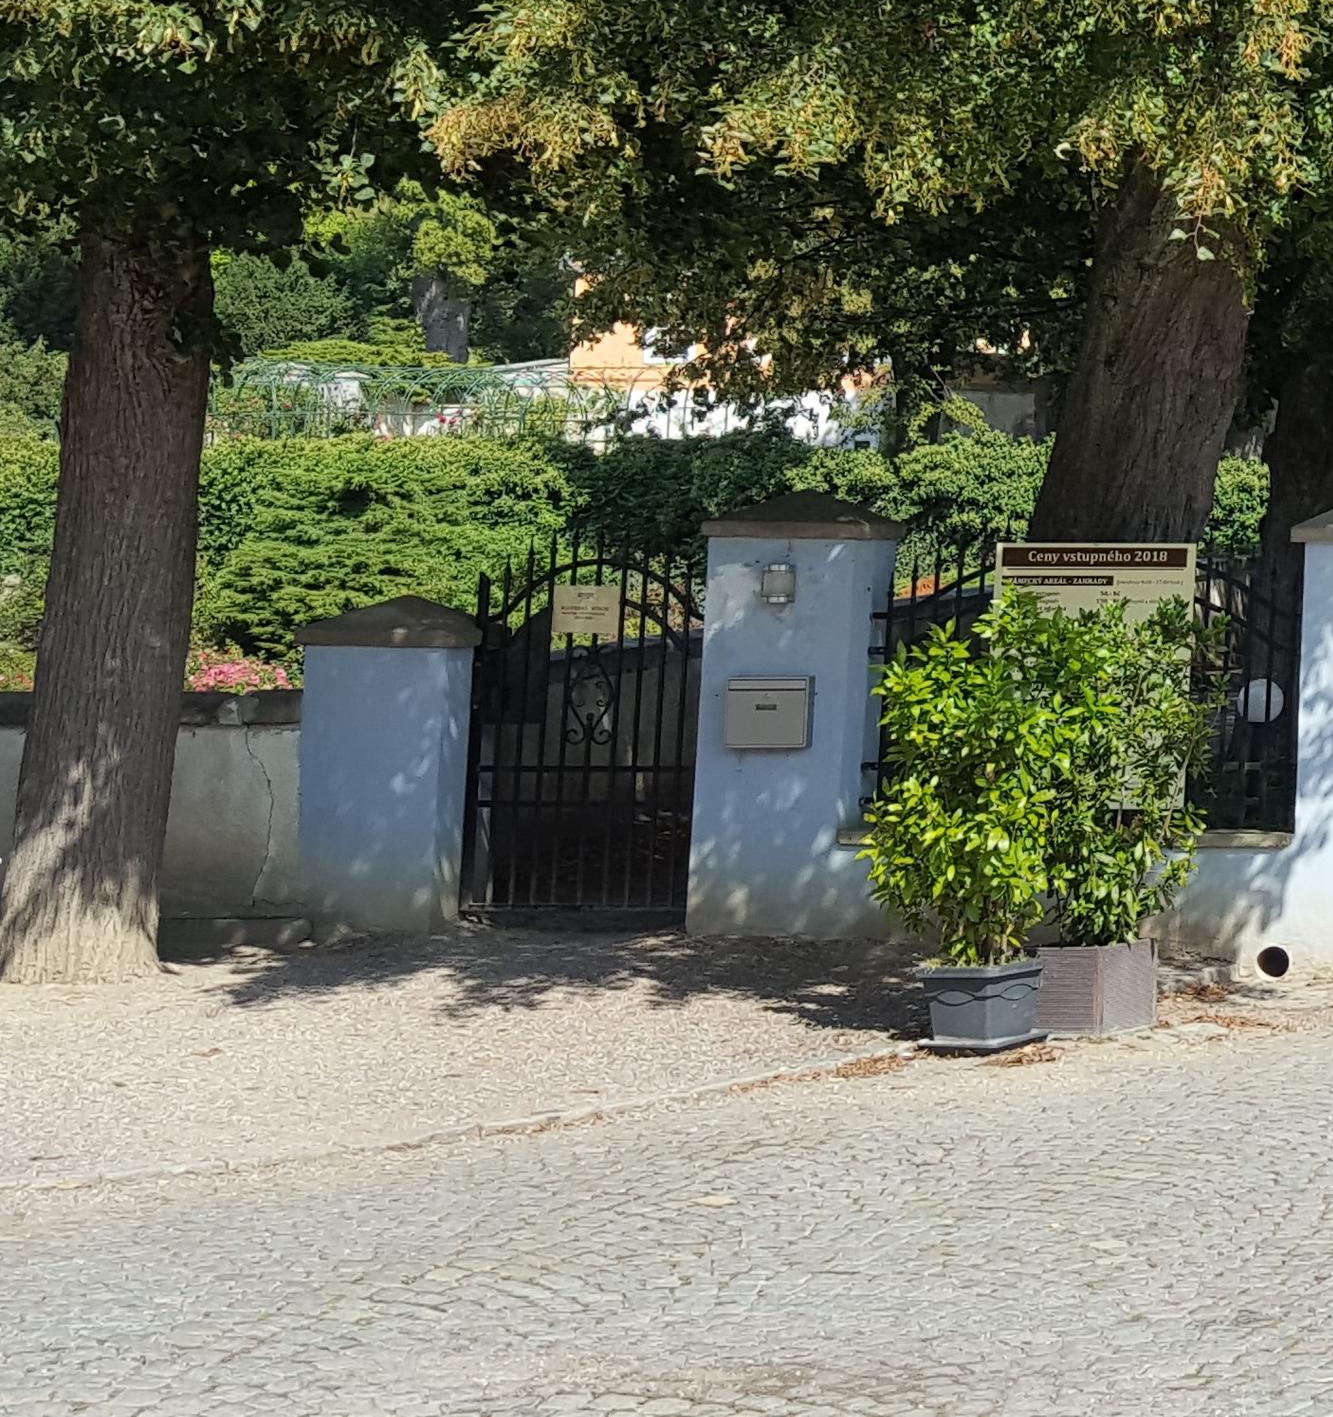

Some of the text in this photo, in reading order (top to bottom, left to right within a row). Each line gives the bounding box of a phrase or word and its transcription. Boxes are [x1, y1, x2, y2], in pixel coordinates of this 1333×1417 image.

[1028, 549, 1168, 565] Ceny vstupného 2018
